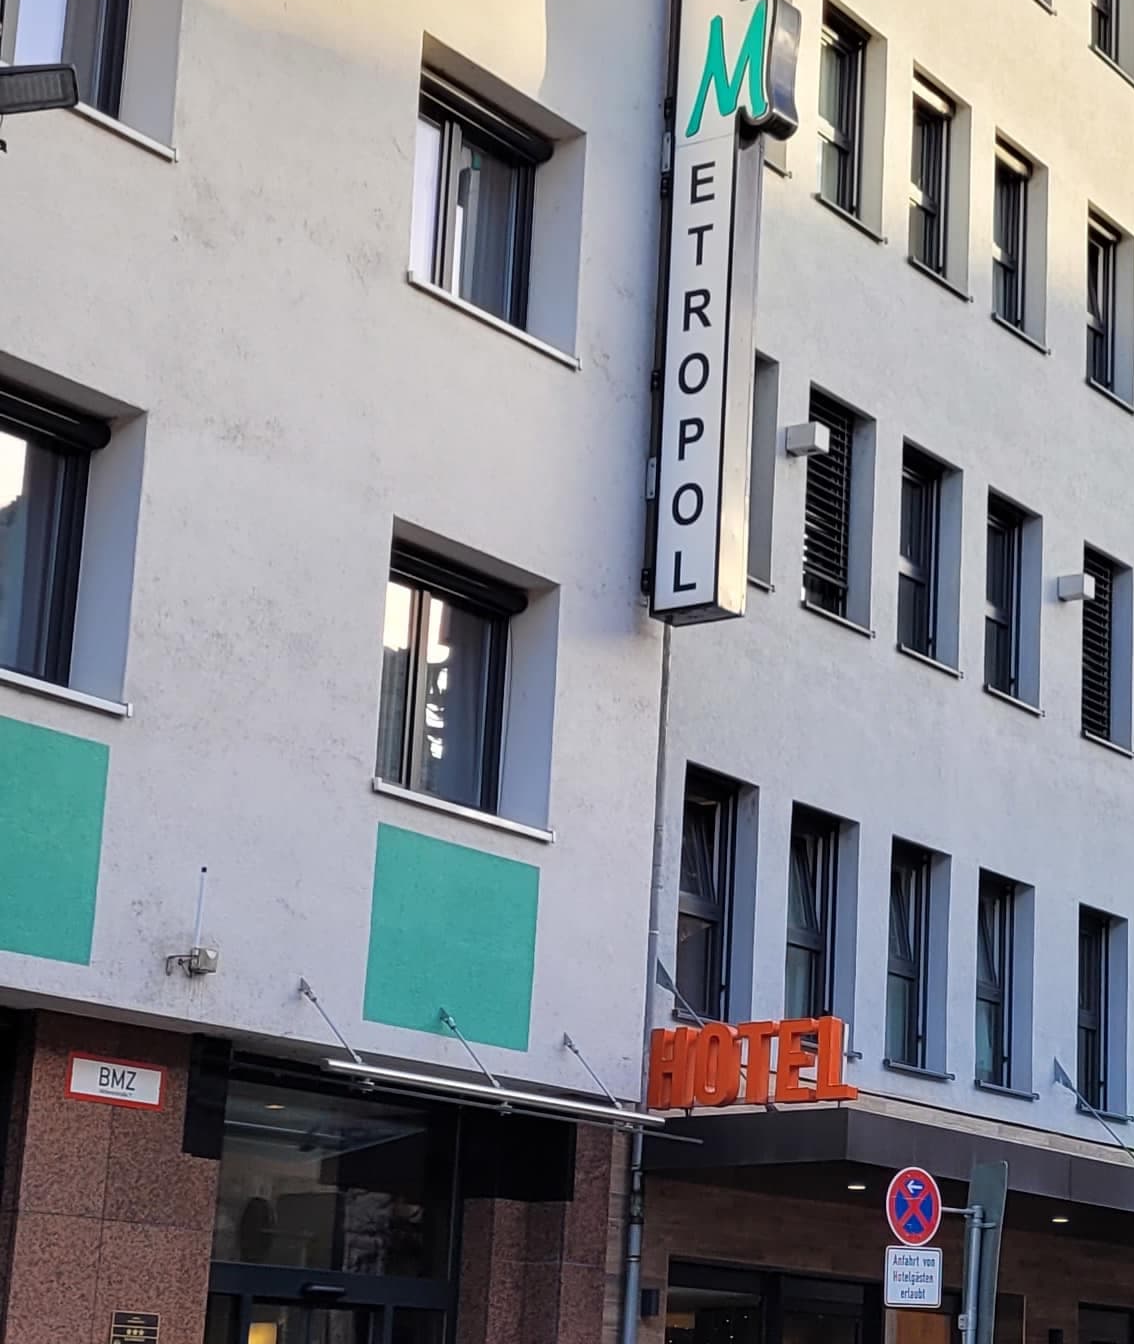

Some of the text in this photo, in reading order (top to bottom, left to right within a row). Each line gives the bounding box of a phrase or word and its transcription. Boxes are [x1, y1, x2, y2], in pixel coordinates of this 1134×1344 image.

[648, 1016, 858, 1110] HOTEL
[98, 1066, 137, 1091] BMZ
[892, 1254, 936, 1267] Anfahrt von
[893, 1271, 934, 1286] Hotelgästen
[900, 1288, 926, 1299] erlaubt
